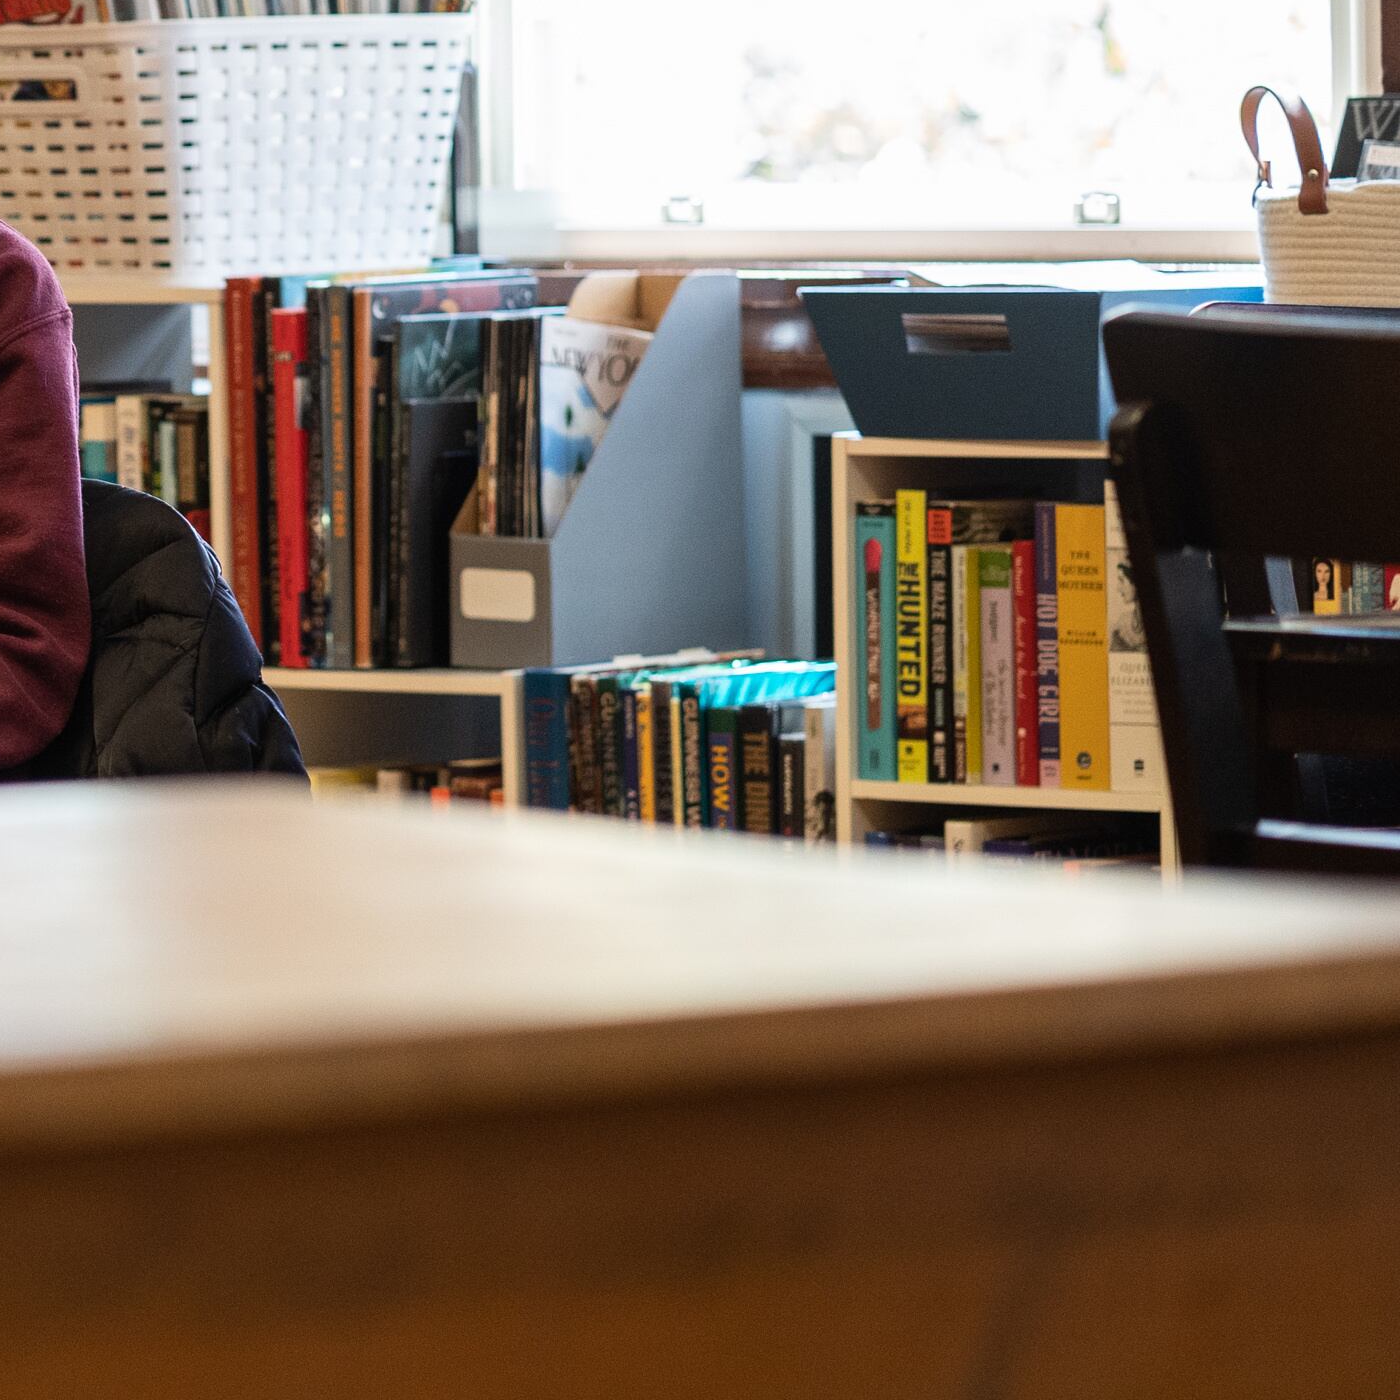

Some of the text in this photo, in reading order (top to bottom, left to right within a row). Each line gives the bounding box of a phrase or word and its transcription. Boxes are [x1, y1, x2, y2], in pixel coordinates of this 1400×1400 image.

[1351, 99, 1400, 141] W
[898, 561, 919, 578] THE
[931, 550, 947, 684] THE MAZE RUNNER
[1037, 592, 1059, 629] HOT
[898, 579, 922, 698] HUNTED
[1038, 638, 1059, 676] DOG
[1038, 684, 1060, 724] GIRL
[683, 697, 701, 803] GUINNESS
[743, 731, 770, 775] THE
[710, 744, 731, 812] HOW
